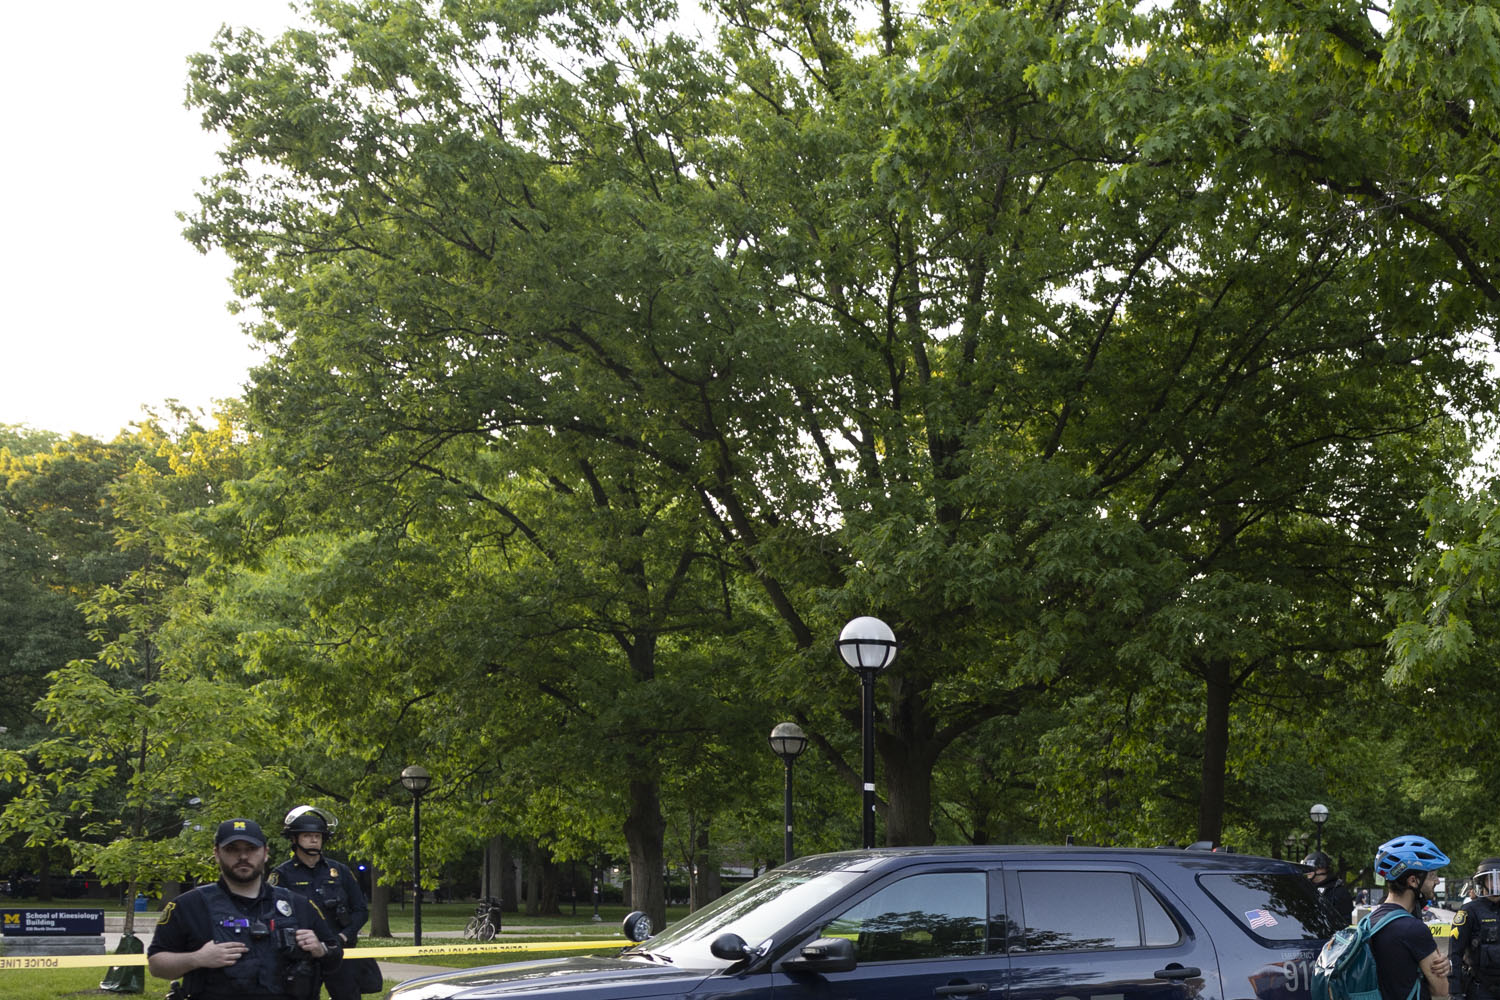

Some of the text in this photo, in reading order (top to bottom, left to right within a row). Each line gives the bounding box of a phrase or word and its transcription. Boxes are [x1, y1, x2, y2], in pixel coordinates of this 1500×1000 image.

[4, 914, 20, 924] M
[59, 912, 99, 920] Kinesiology
[0, 959, 58, 968] POLICE LINE
